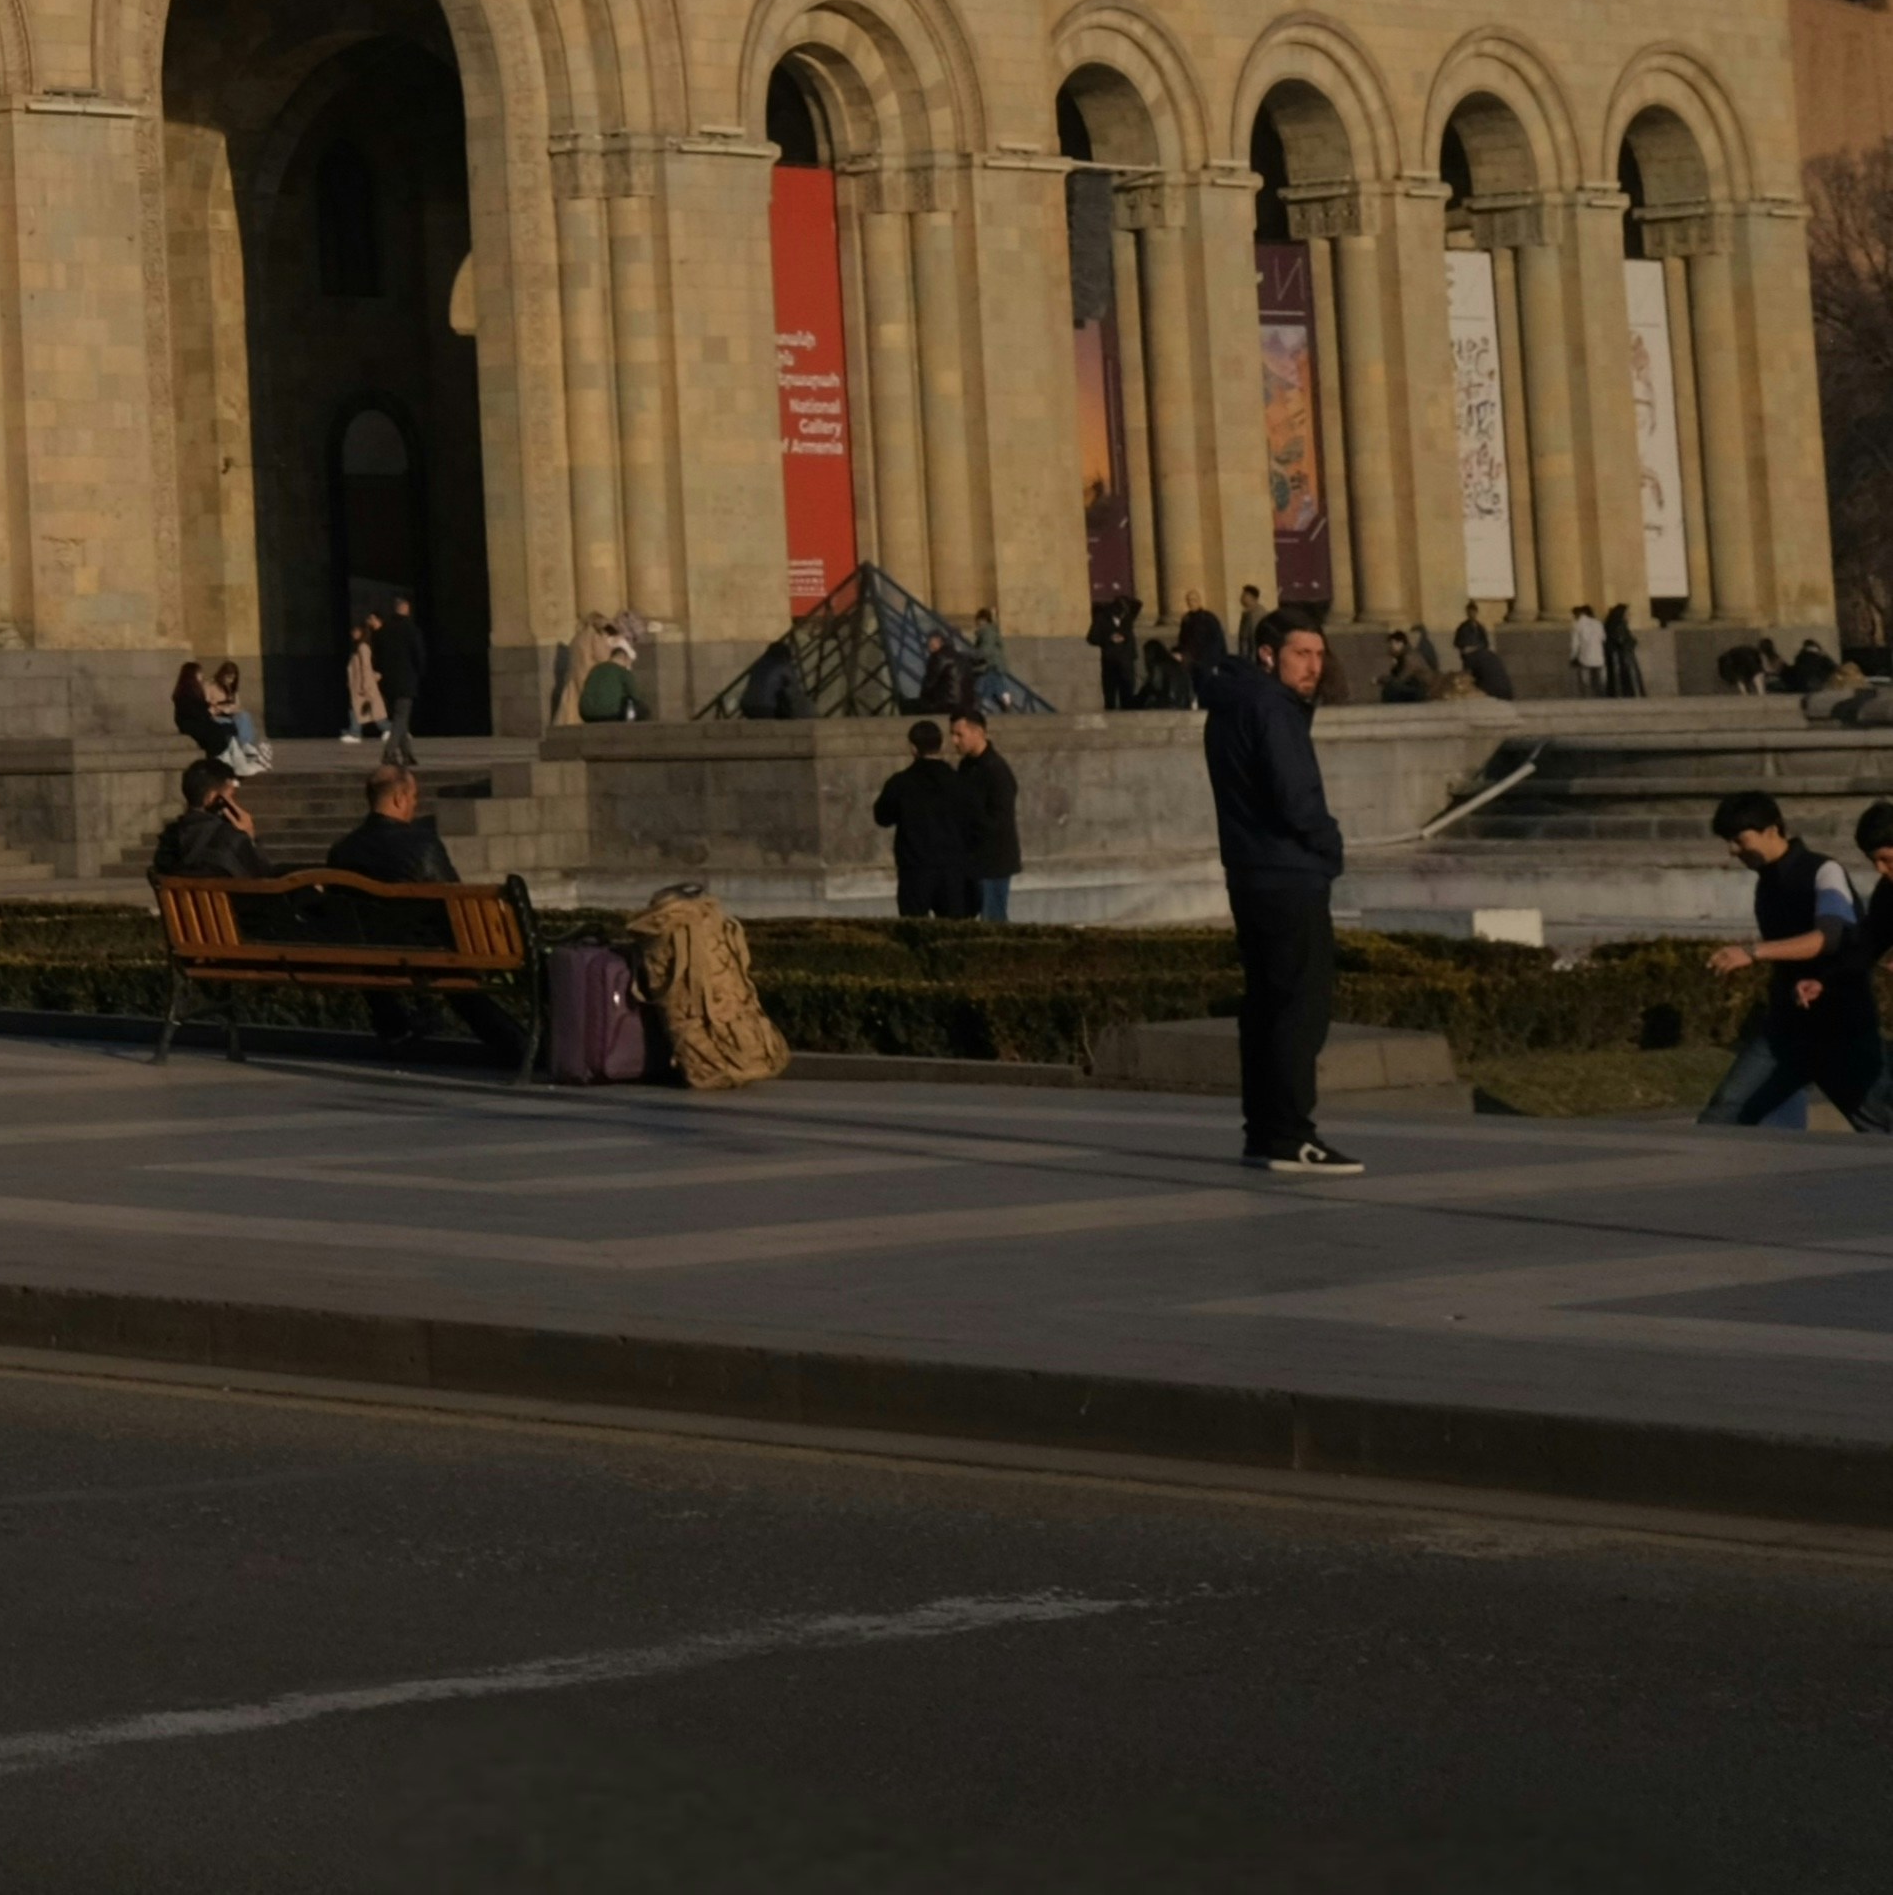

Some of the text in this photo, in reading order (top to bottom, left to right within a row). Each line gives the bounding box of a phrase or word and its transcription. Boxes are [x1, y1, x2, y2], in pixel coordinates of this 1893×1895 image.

[789, 398, 840, 414] National
[799, 418, 842, 439] Gallery
[791, 438, 844, 455] Armenia
